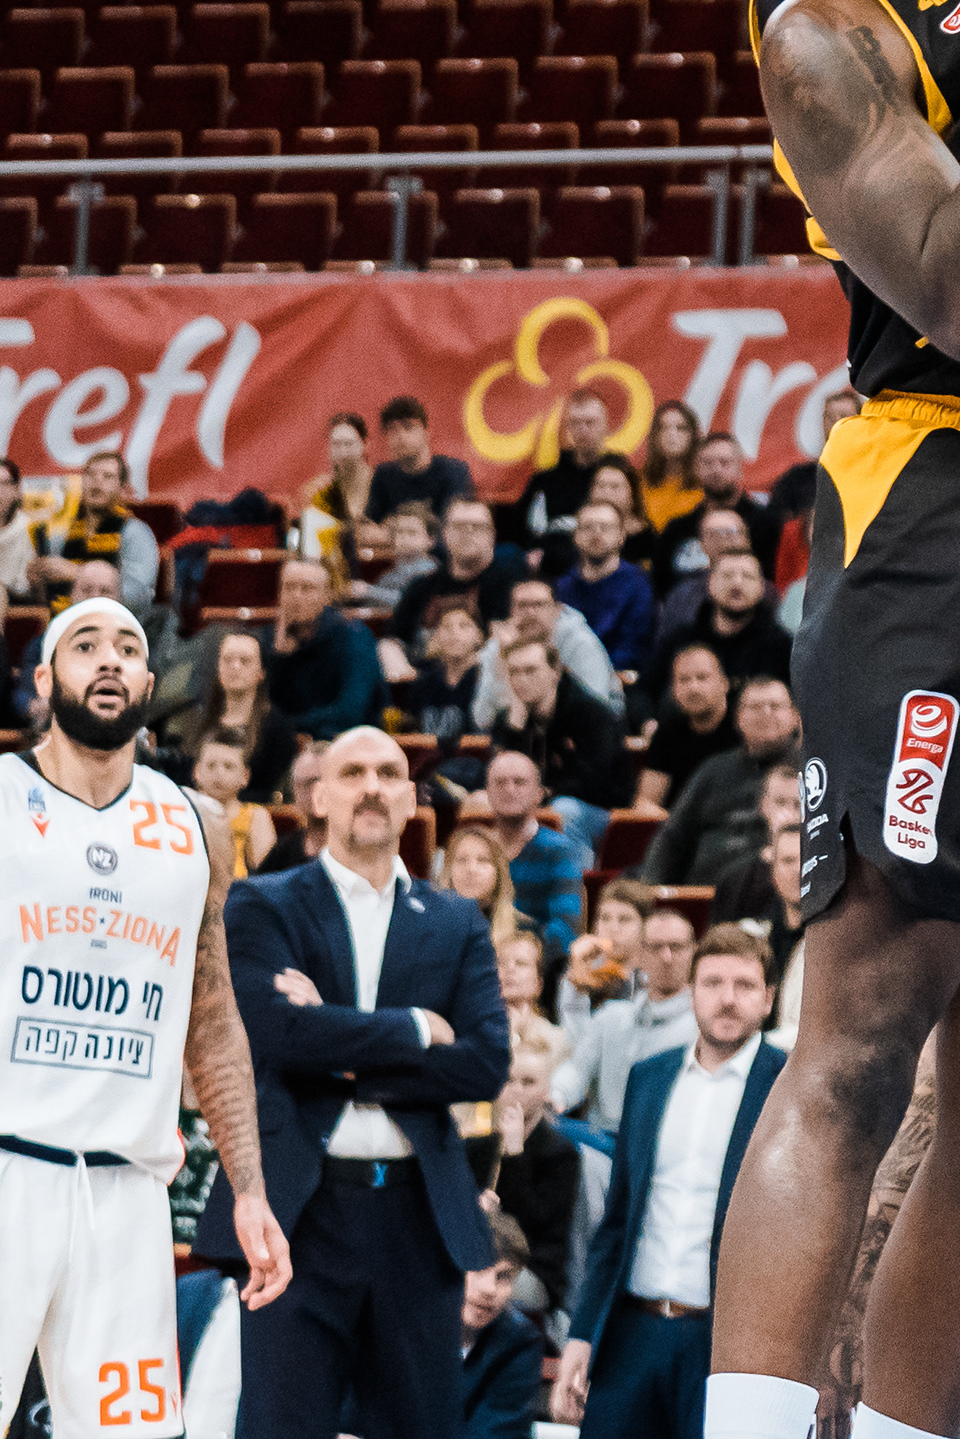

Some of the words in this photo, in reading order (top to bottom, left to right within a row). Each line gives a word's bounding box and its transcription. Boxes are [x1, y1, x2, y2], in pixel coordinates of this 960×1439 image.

[906, 738, 944, 754] Energa
[129, 799, 195, 856] 25
[898, 832, 926, 850] Liga
[92, 846, 113, 867] NZ
[89, 887, 123, 904] IRONI
[18, 902, 97, 943] NESS
[105, 910, 182, 967] ZIONA
[21, 965, 131, 1015] מוטורס
[142, 981, 164, 1021] חי
[25, 1026, 78, 1061] קפה
[84, 1033, 145, 1065] ציונה
[98, 1358, 166, 1426] 25
